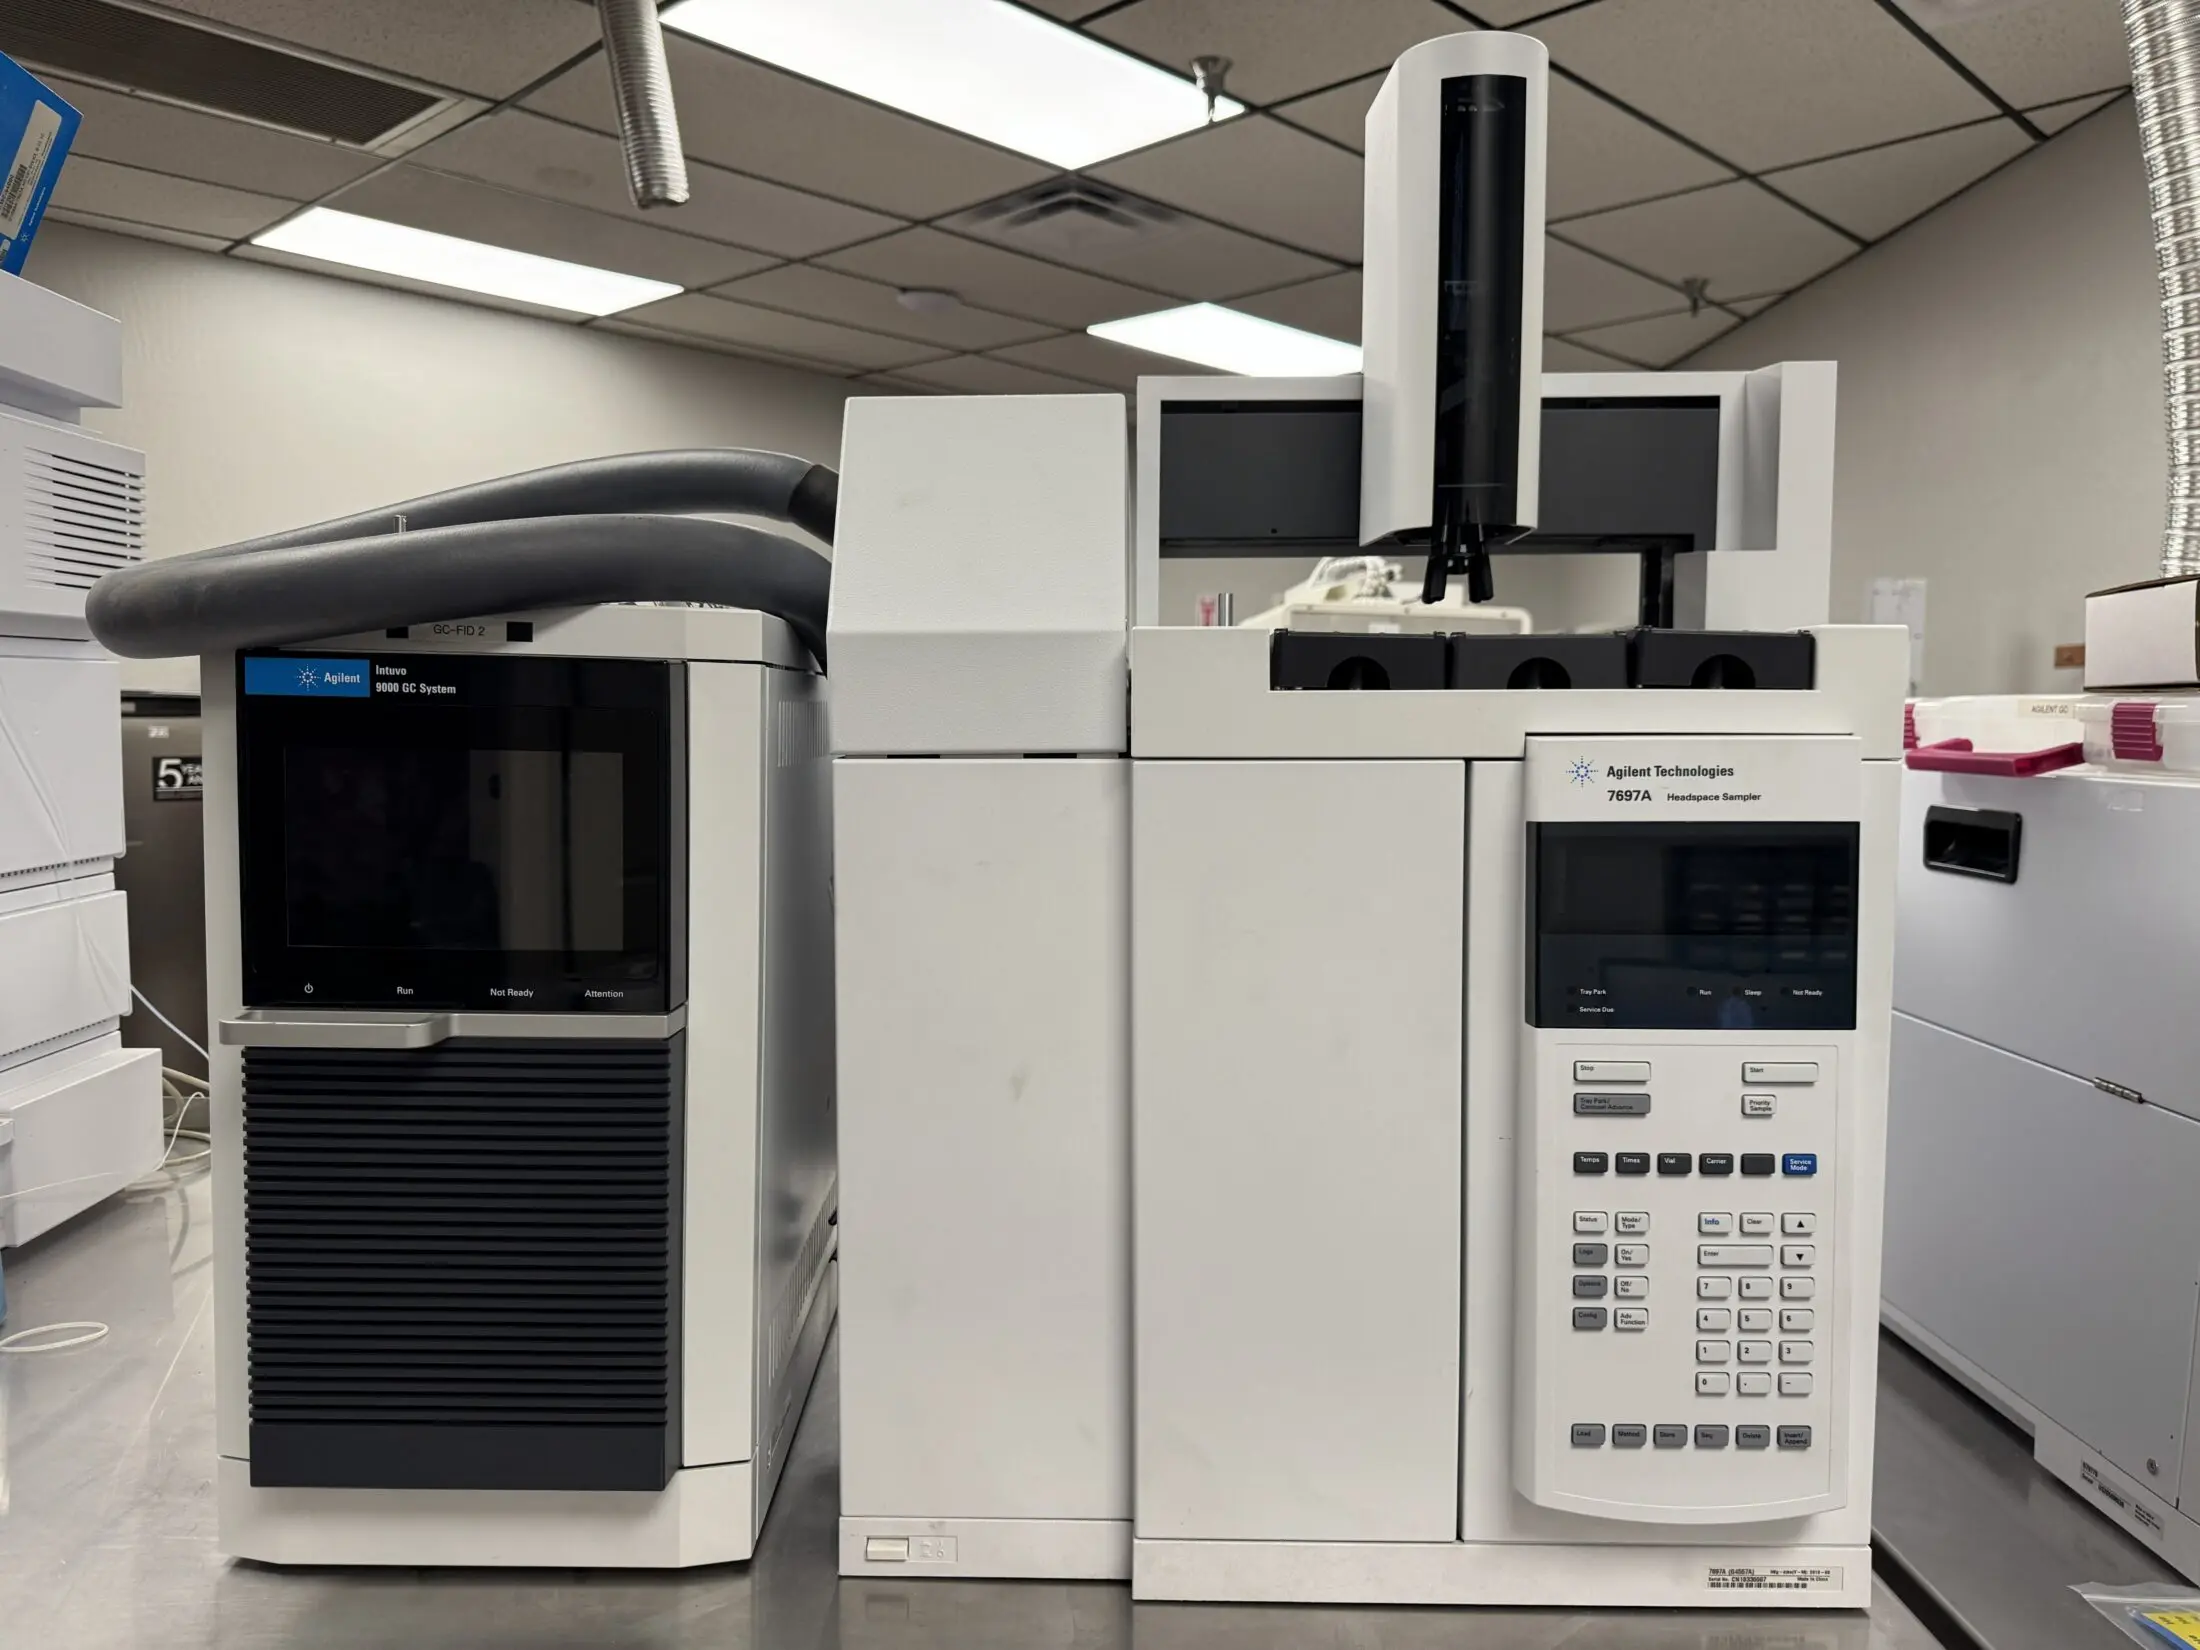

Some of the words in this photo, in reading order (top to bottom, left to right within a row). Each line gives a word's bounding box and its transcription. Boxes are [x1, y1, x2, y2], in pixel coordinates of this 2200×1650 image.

[433, 624, 475, 636] GC-FID
[477, 625, 486, 636] 2
[375, 664, 407, 676] Intuvo
[323, 671, 361, 684] Agilent
[375, 682, 399, 693] 9000
[402, 682, 417, 693] GC
[419, 683, 456, 696] System
[1606, 765, 1651, 780] Agilent
[1654, 765, 1734, 779] Technologies
[1607, 789, 1652, 802] 7697A
[1667, 792, 1720, 803] Headspace
[1721, 792, 1762, 803] Sampler
[396, 986, 414, 995] Run
[490, 987, 505, 997] Not
[507, 987, 534, 998] Ready
[584, 989, 624, 998] Attention
[1580, 988, 1592, 996] Tray
[1744, 989, 1762, 997] Sleep
[1804, 989, 1823, 997] Ready
[1580, 1064, 1594, 1072] Stop
[1580, 1156, 1600, 1164] Temps
[1622, 1156, 1641, 1164] Times
